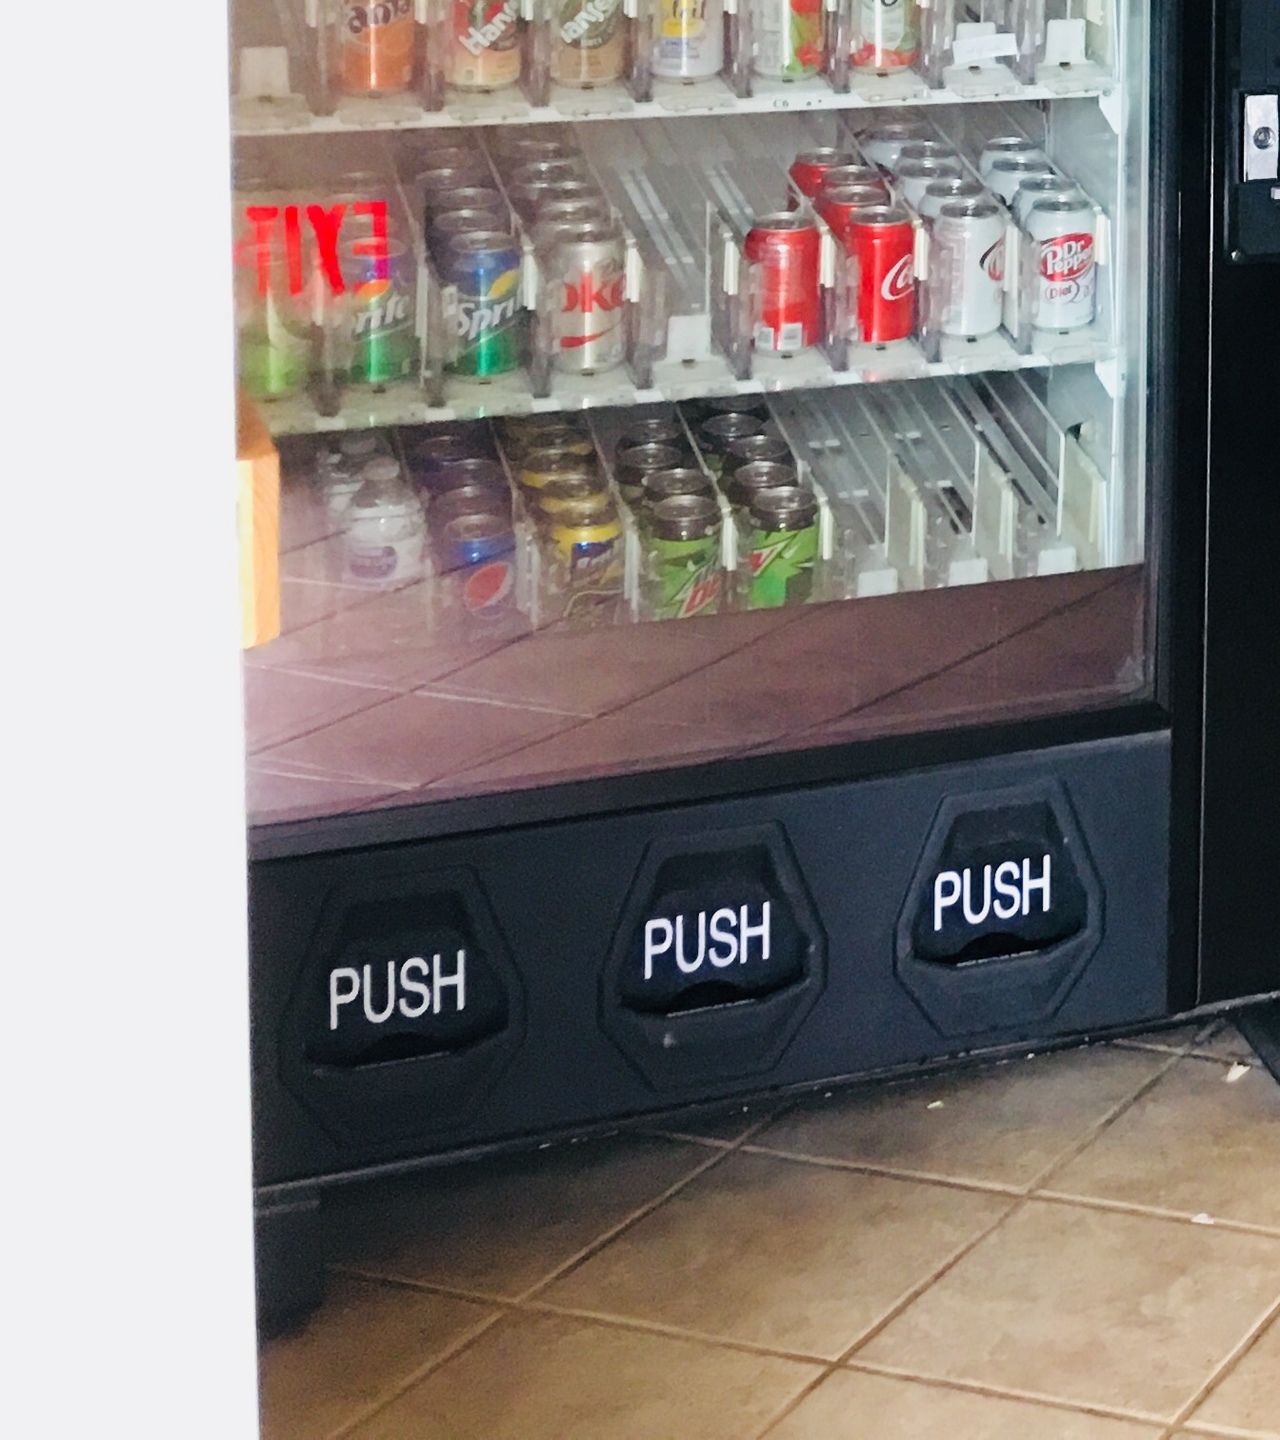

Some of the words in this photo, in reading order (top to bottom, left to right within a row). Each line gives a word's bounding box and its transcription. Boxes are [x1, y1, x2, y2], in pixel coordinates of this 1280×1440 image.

[1046, 248, 1094, 276] Peppe
[1066, 240, 1085, 255] Dr
[454, 298, 515, 341] Spri
[934, 854, 1051, 931] PUSH
[644, 901, 771, 979] PUSH
[329, 950, 466, 1031] PUSH
